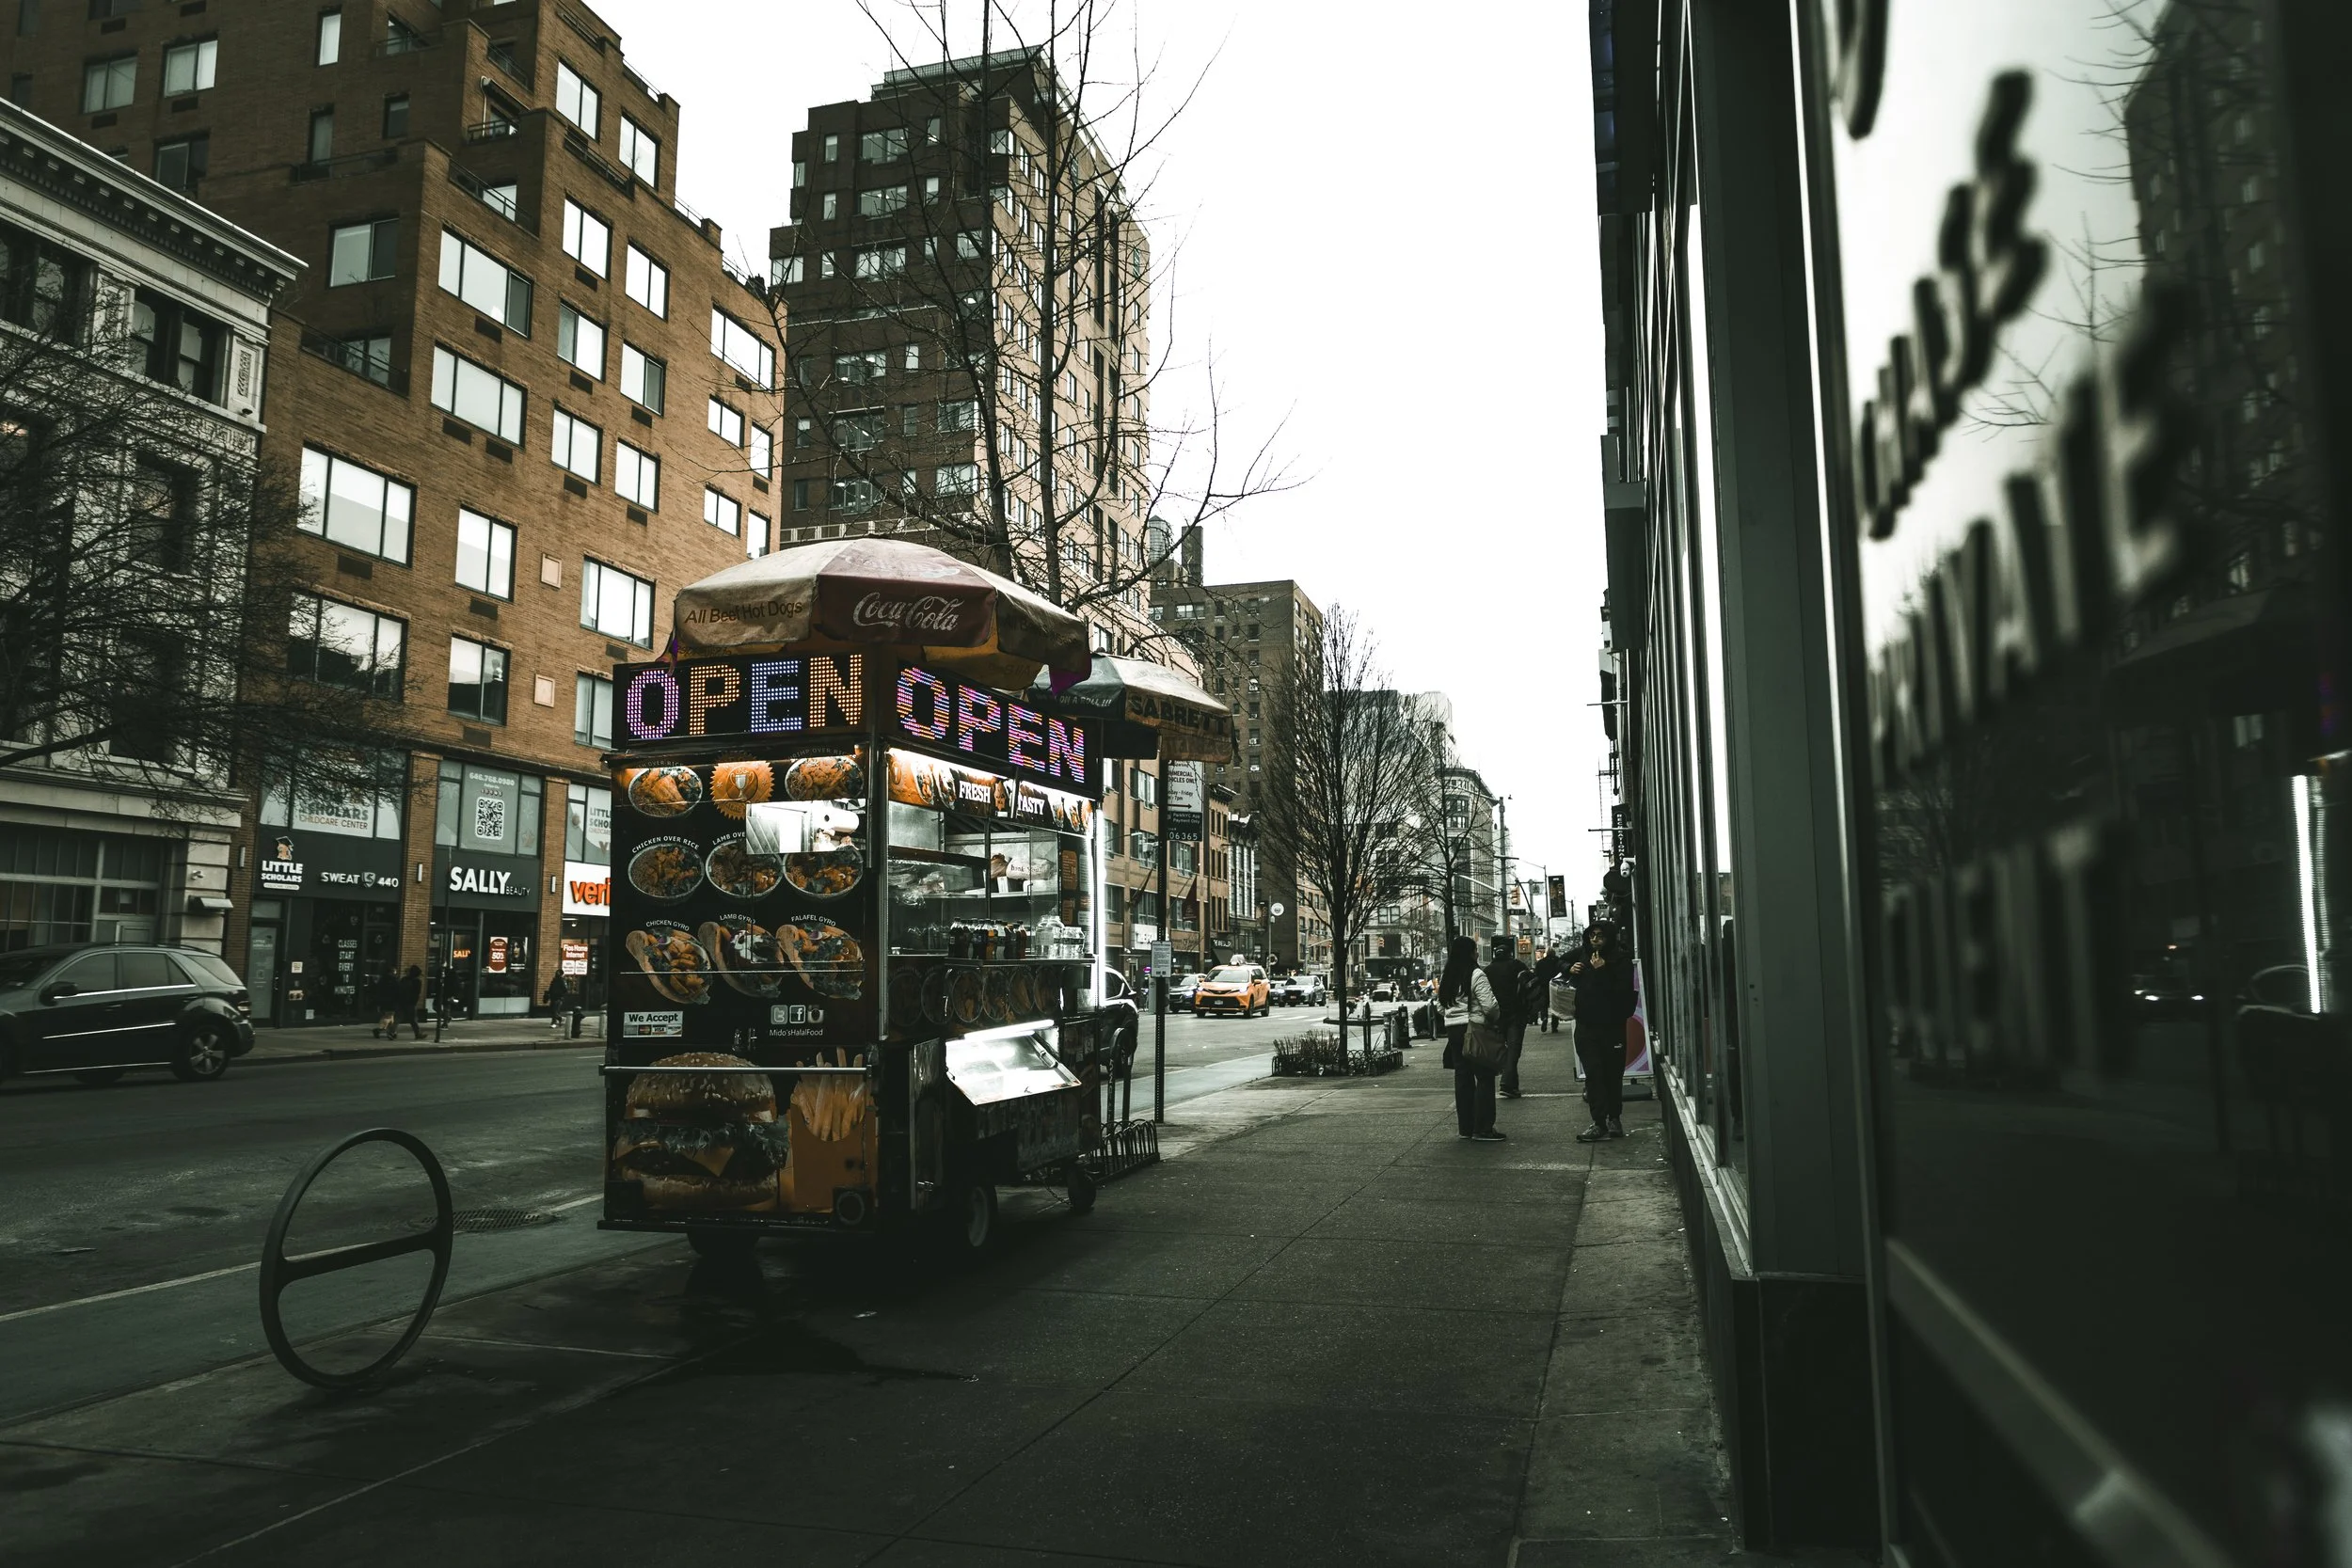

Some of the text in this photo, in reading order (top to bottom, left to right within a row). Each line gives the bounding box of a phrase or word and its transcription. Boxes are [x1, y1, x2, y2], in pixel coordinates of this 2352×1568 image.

[685, 600, 803, 624] All Beef Hot Dogs
[627, 654, 863, 739] OPEN
[1129, 694, 1227, 736] SABRETT
[897, 667, 1085, 783] OPEN
[959, 780, 992, 804] FRESH
[1017, 793, 1045, 816] TASTY
[589, 807, 612, 818] LITTL
[341, 819, 368, 830] CENTER
[589, 817, 612, 829] SCHO
[631, 836, 661, 854] CHICKEN
[683, 838, 700, 850] RICE
[712, 833, 731, 846] LAMB
[262, 860, 304, 875] LITTLE
[261, 872, 303, 883] SCHOLARS
[321, 871, 399, 888] SWEAT 440
[450, 865, 511, 895] SALLY
[505, 886, 531, 896] BEAUTY
[645, 919, 690, 931] CHICKEN GYRO
[818, 916, 836, 927] GYRO
[628, 1012, 678, 1023] We Accept
[769, 1028, 823, 1037] Mido'sHalalFood
